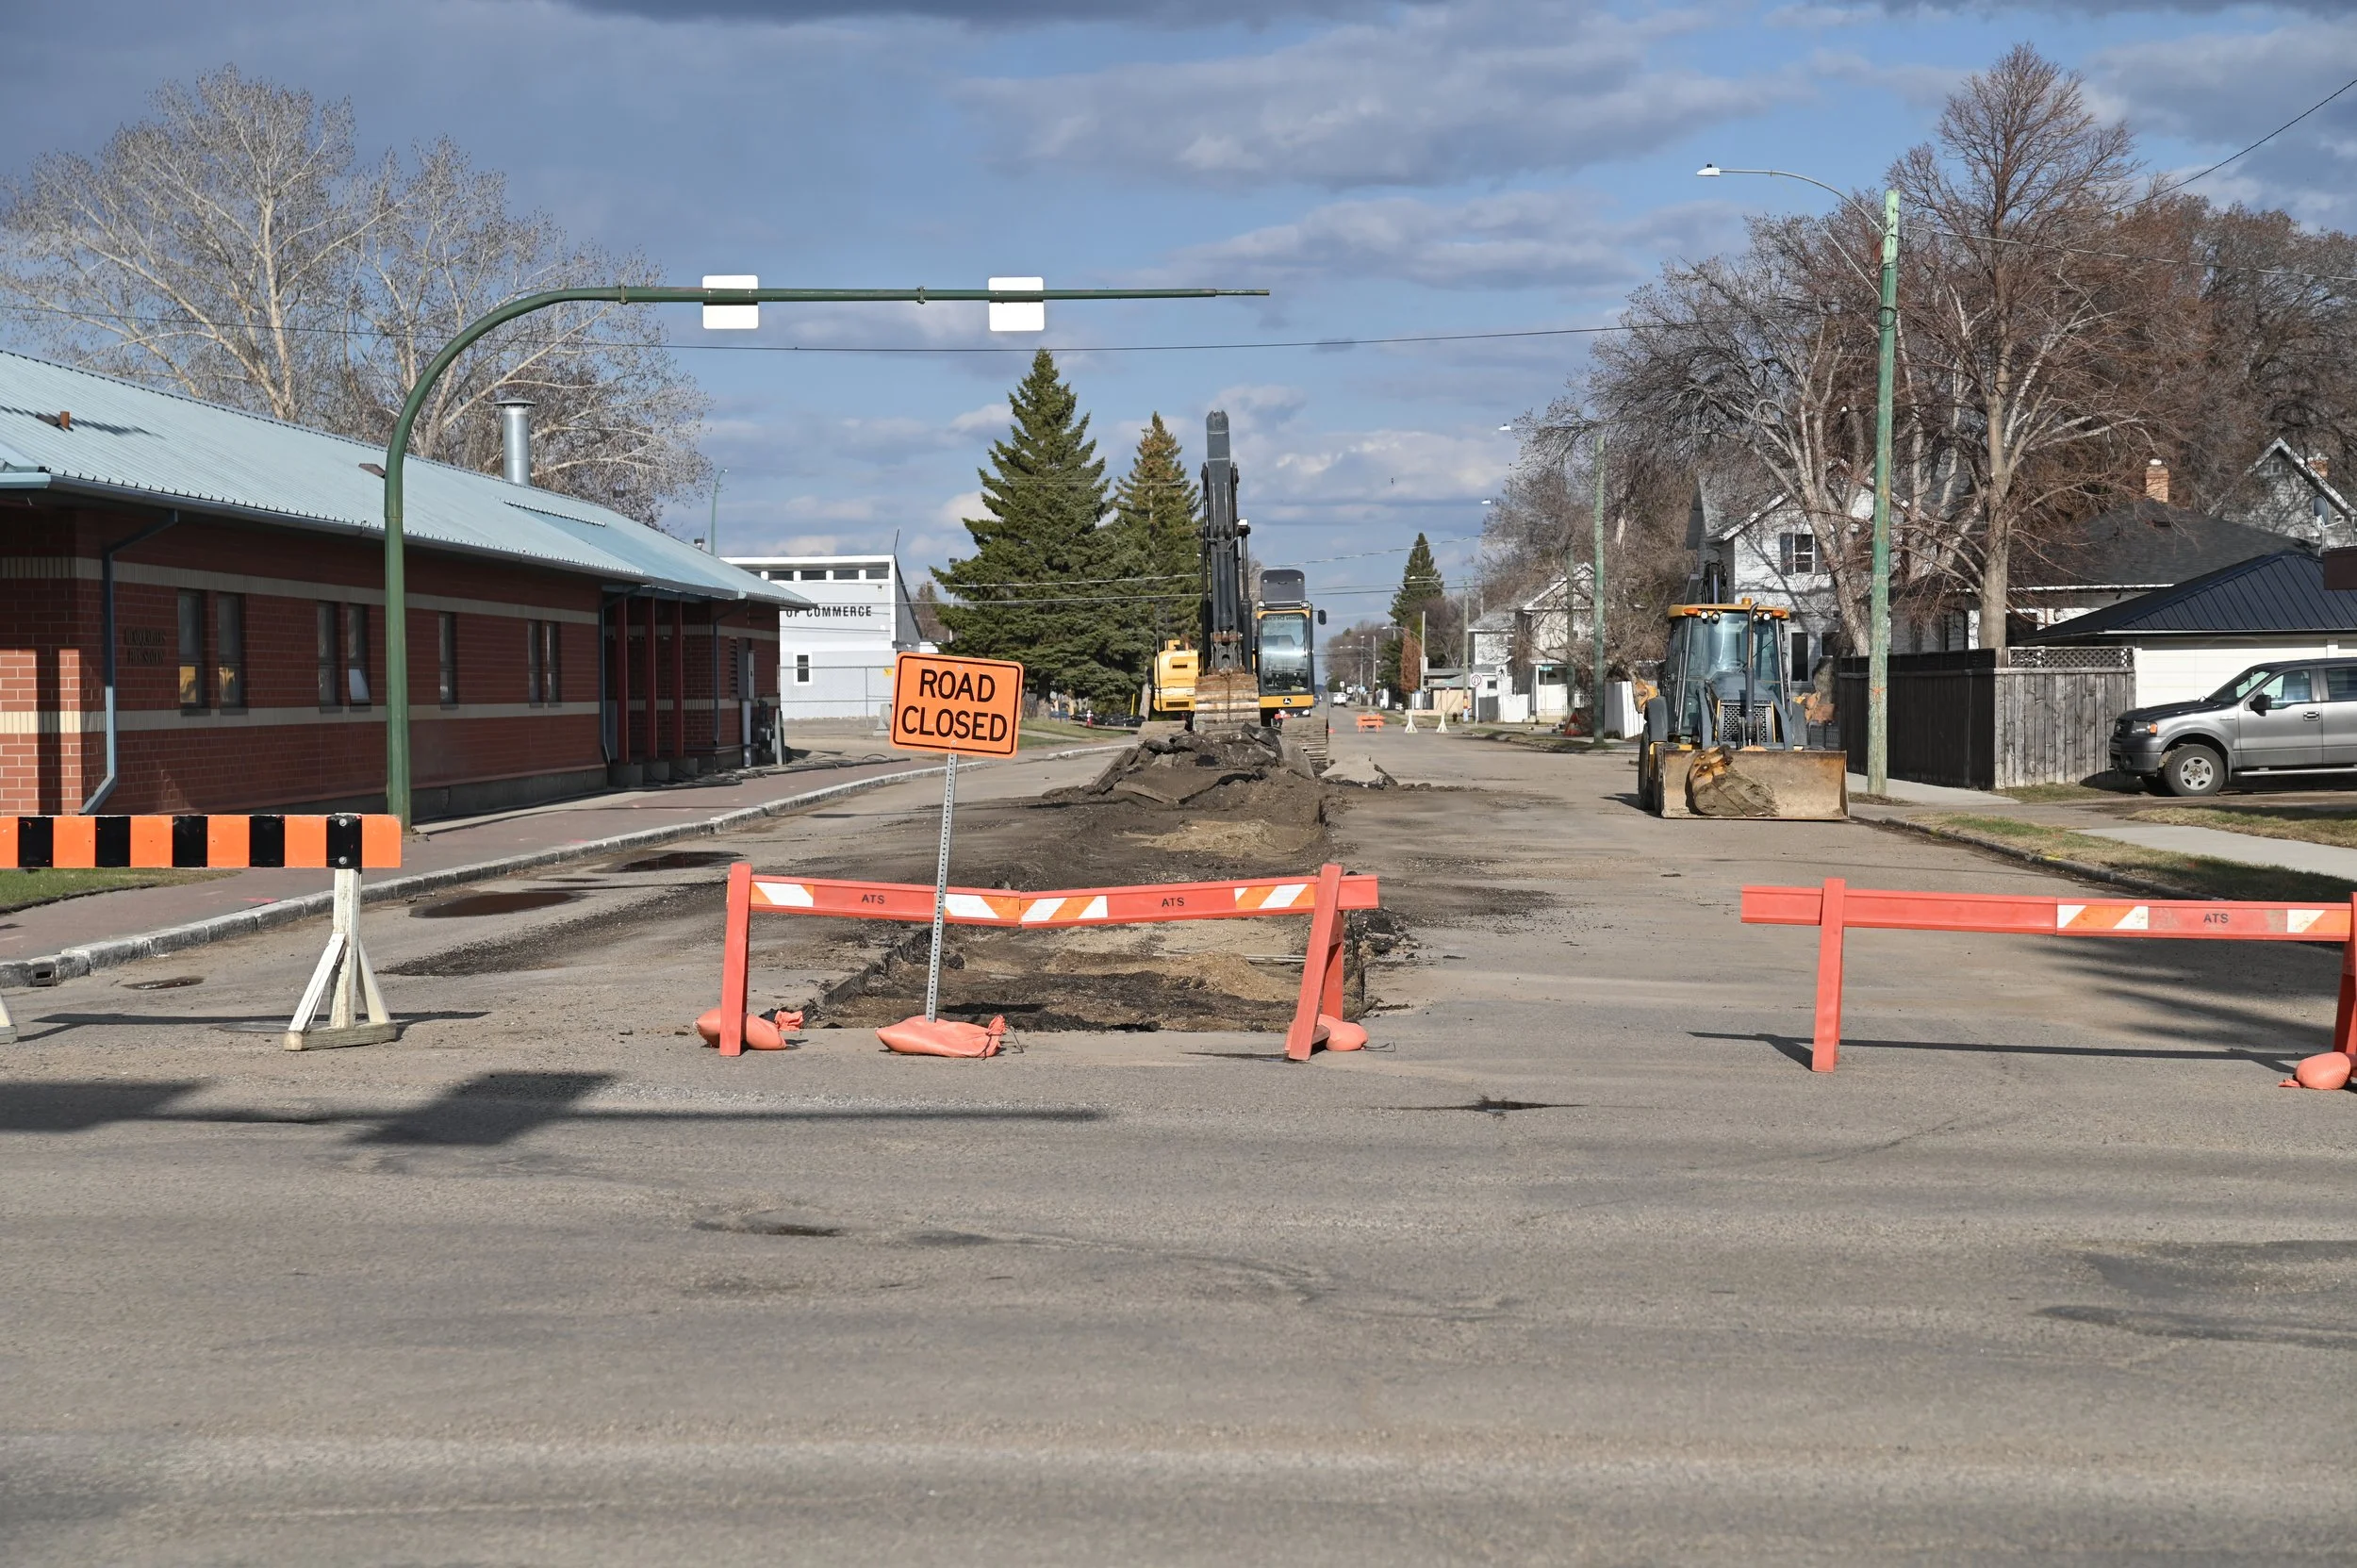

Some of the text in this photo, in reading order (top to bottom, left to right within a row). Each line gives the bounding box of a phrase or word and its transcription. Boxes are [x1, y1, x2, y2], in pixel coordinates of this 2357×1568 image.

[806, 605, 872, 618] COMMERCE
[919, 668, 996, 702] ROAD
[901, 705, 1008, 742] CLOSED
[861, 894, 884, 904] ATS
[1162, 897, 1185, 907] ATS
[2203, 913, 2229, 924] ATS
